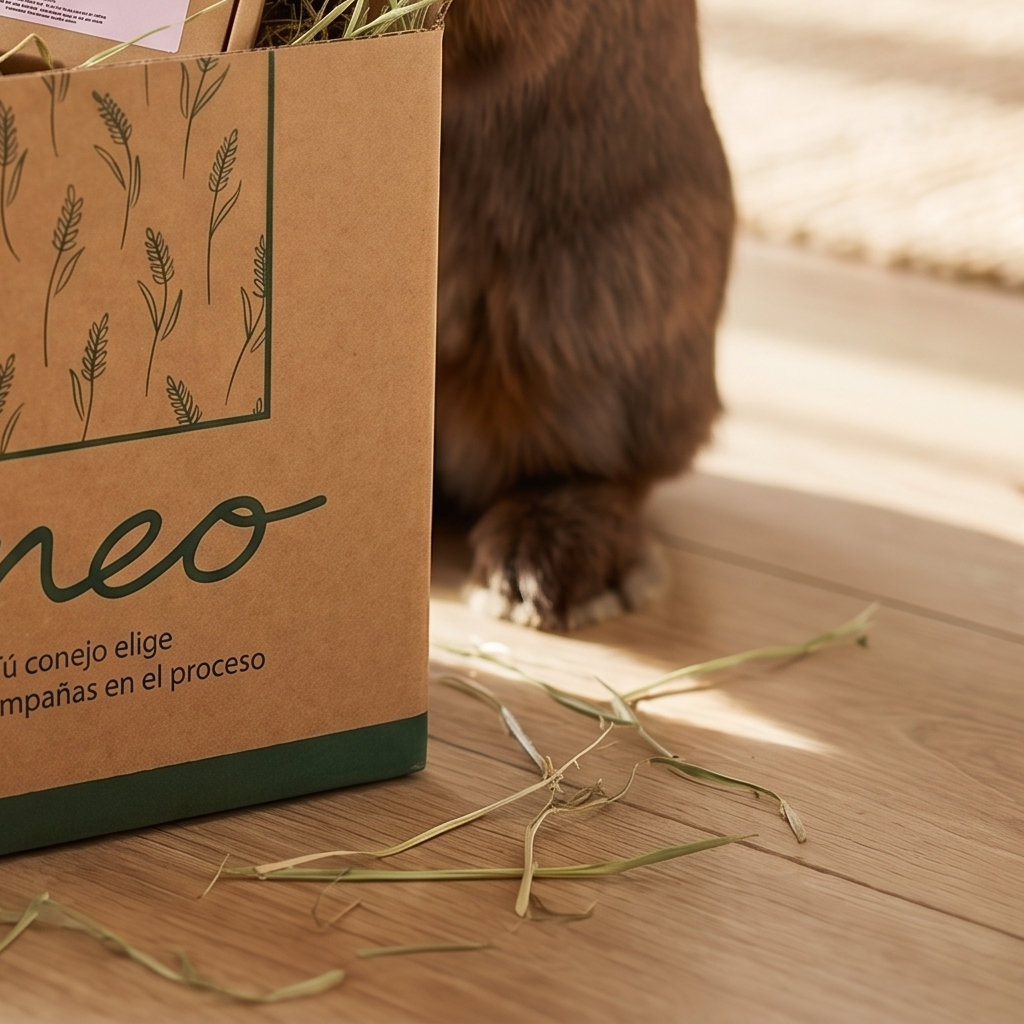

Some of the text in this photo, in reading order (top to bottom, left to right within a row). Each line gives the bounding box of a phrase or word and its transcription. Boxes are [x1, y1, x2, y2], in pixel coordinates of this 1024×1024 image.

[25, 640, 107, 674] conejo
[114, 629, 172, 663] elige
[105, 676, 134, 696] en
[142, 666, 162, 689] el
[171, 651, 265, 690] proceso
